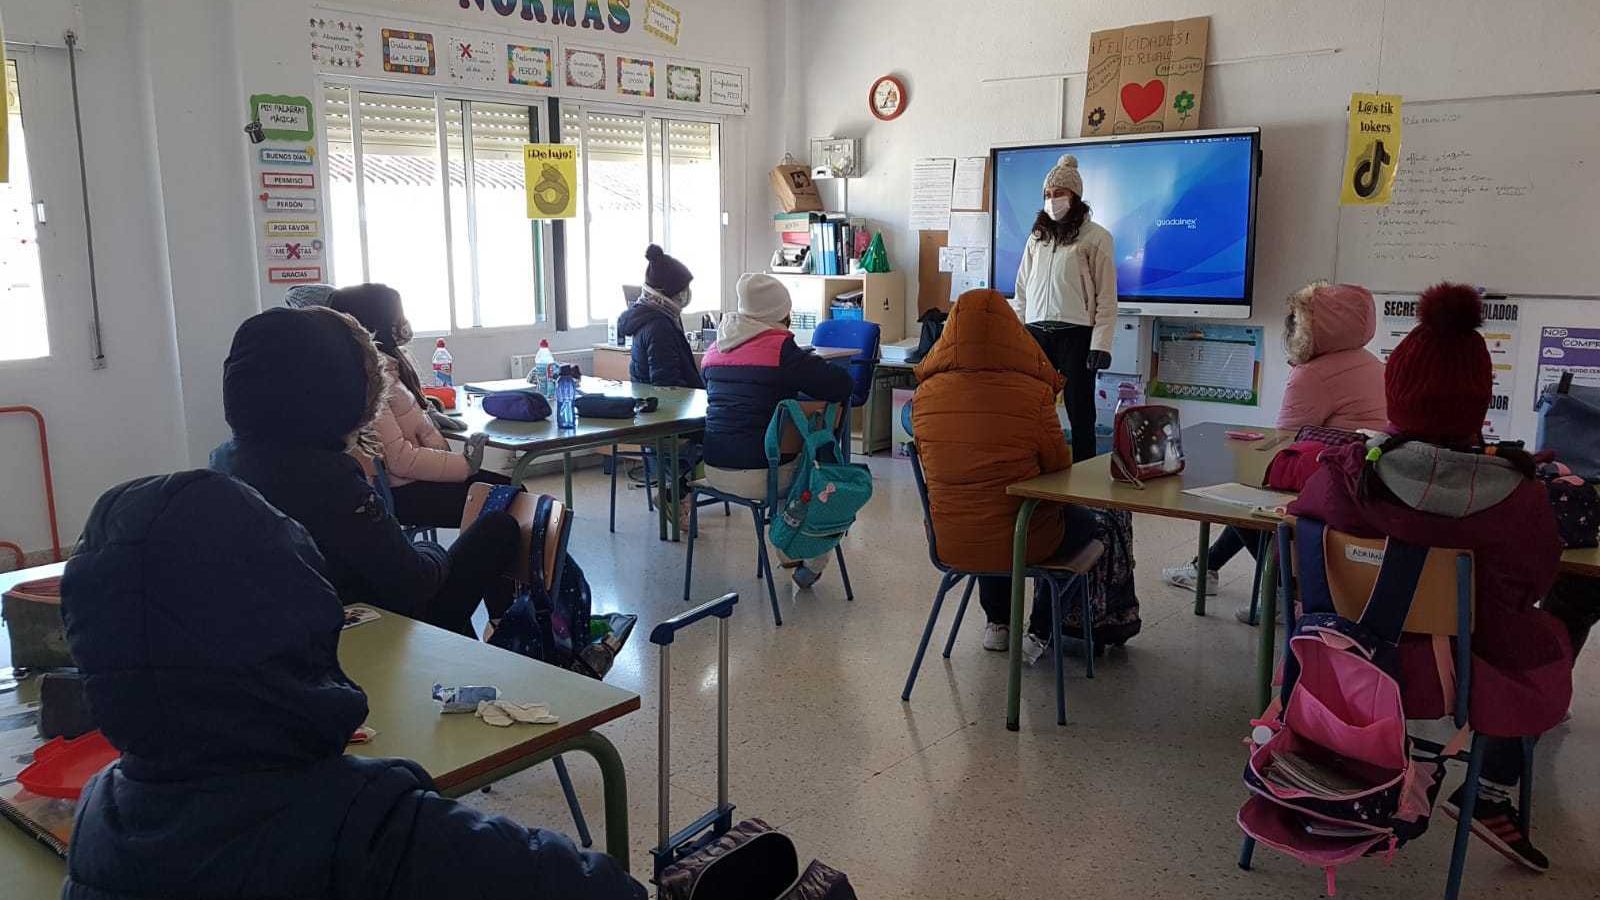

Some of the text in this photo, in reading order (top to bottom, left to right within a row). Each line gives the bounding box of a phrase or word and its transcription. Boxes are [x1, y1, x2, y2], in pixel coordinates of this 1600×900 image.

[459, 0, 631, 34] RMAS
[1360, 120, 1391, 132] tokers
[276, 200, 304, 208] PERDÓN
[1156, 217, 1197, 227] guadalinex
[281, 271, 308, 279] GRACIAS
[1384, 301, 1518, 320] SECRE OLADOR
[1544, 329, 1567, 337] NOS
[1489, 395, 1509, 411] DOR
